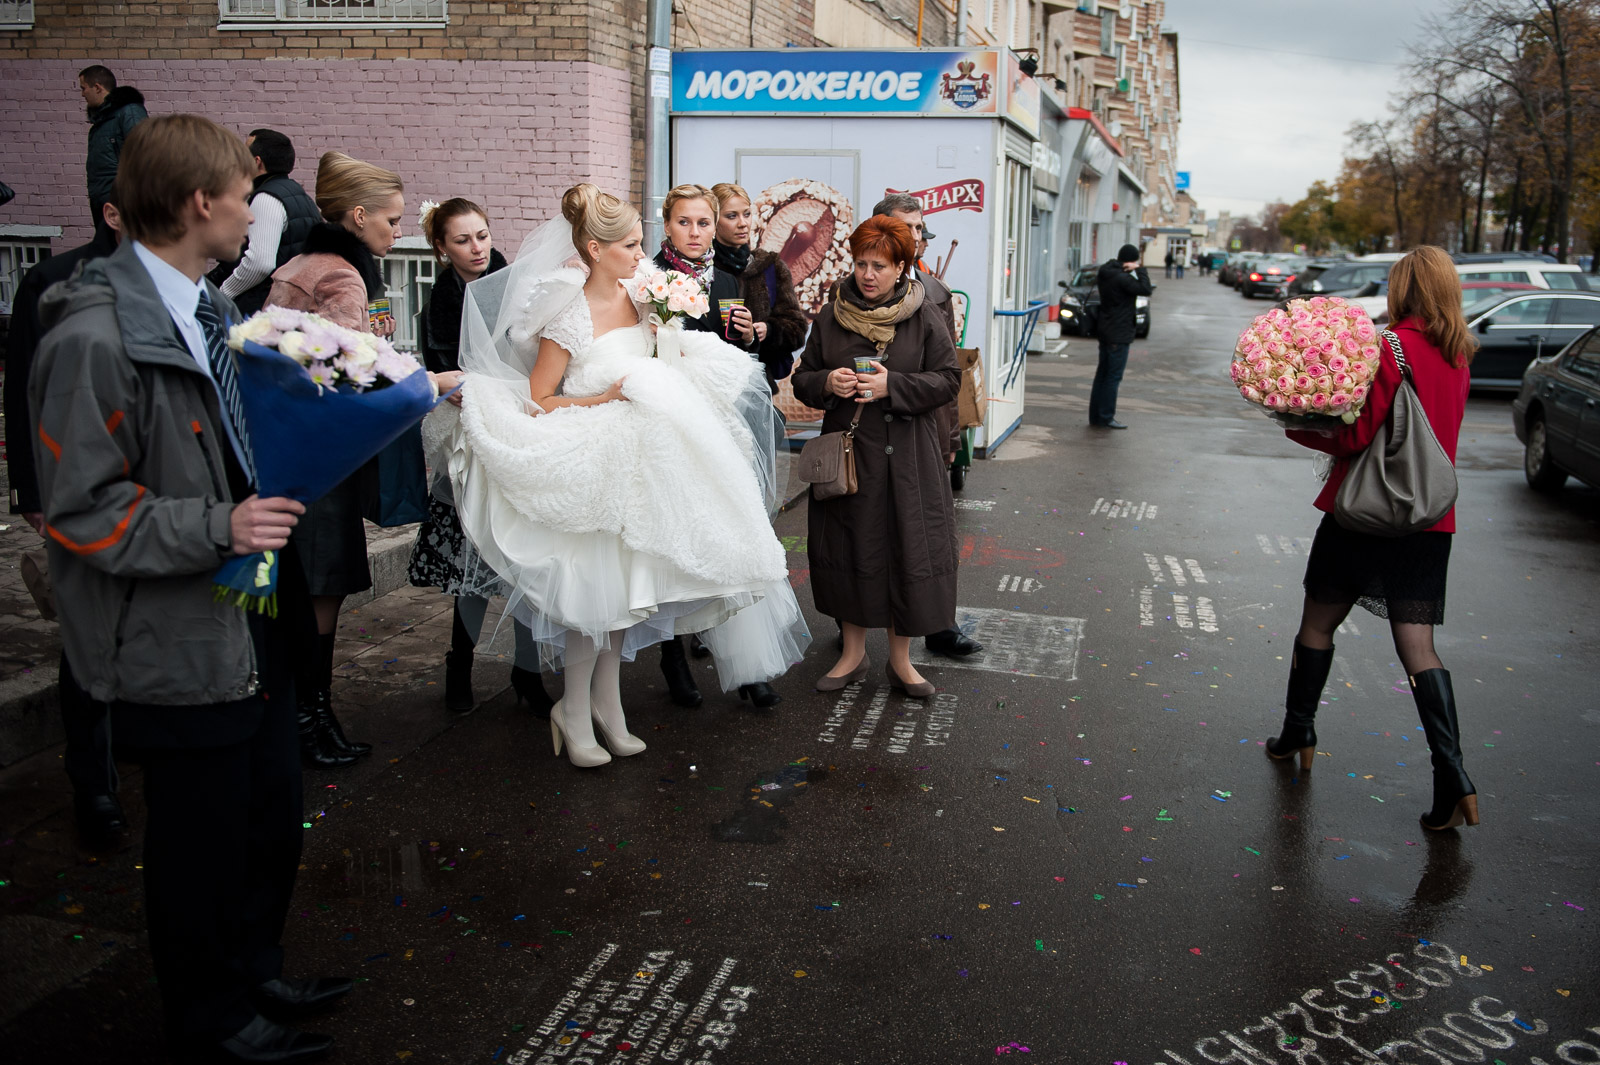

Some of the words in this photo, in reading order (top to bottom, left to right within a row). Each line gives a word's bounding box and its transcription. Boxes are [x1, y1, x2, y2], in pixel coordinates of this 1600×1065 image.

[686, 70, 922, 101] МОРОЖЕНОЕ
[922, 693, 959, 746] СВАДЬБА
[527, 1036, 543, 1047] в
[536, 990, 580, 1035] центре
[572, 943, 620, 989] Москвы
[609, 950, 674, 1012] РЫБКА
[650, 958, 694, 1011] рублей
[661, 1036, 687, 1061] без
